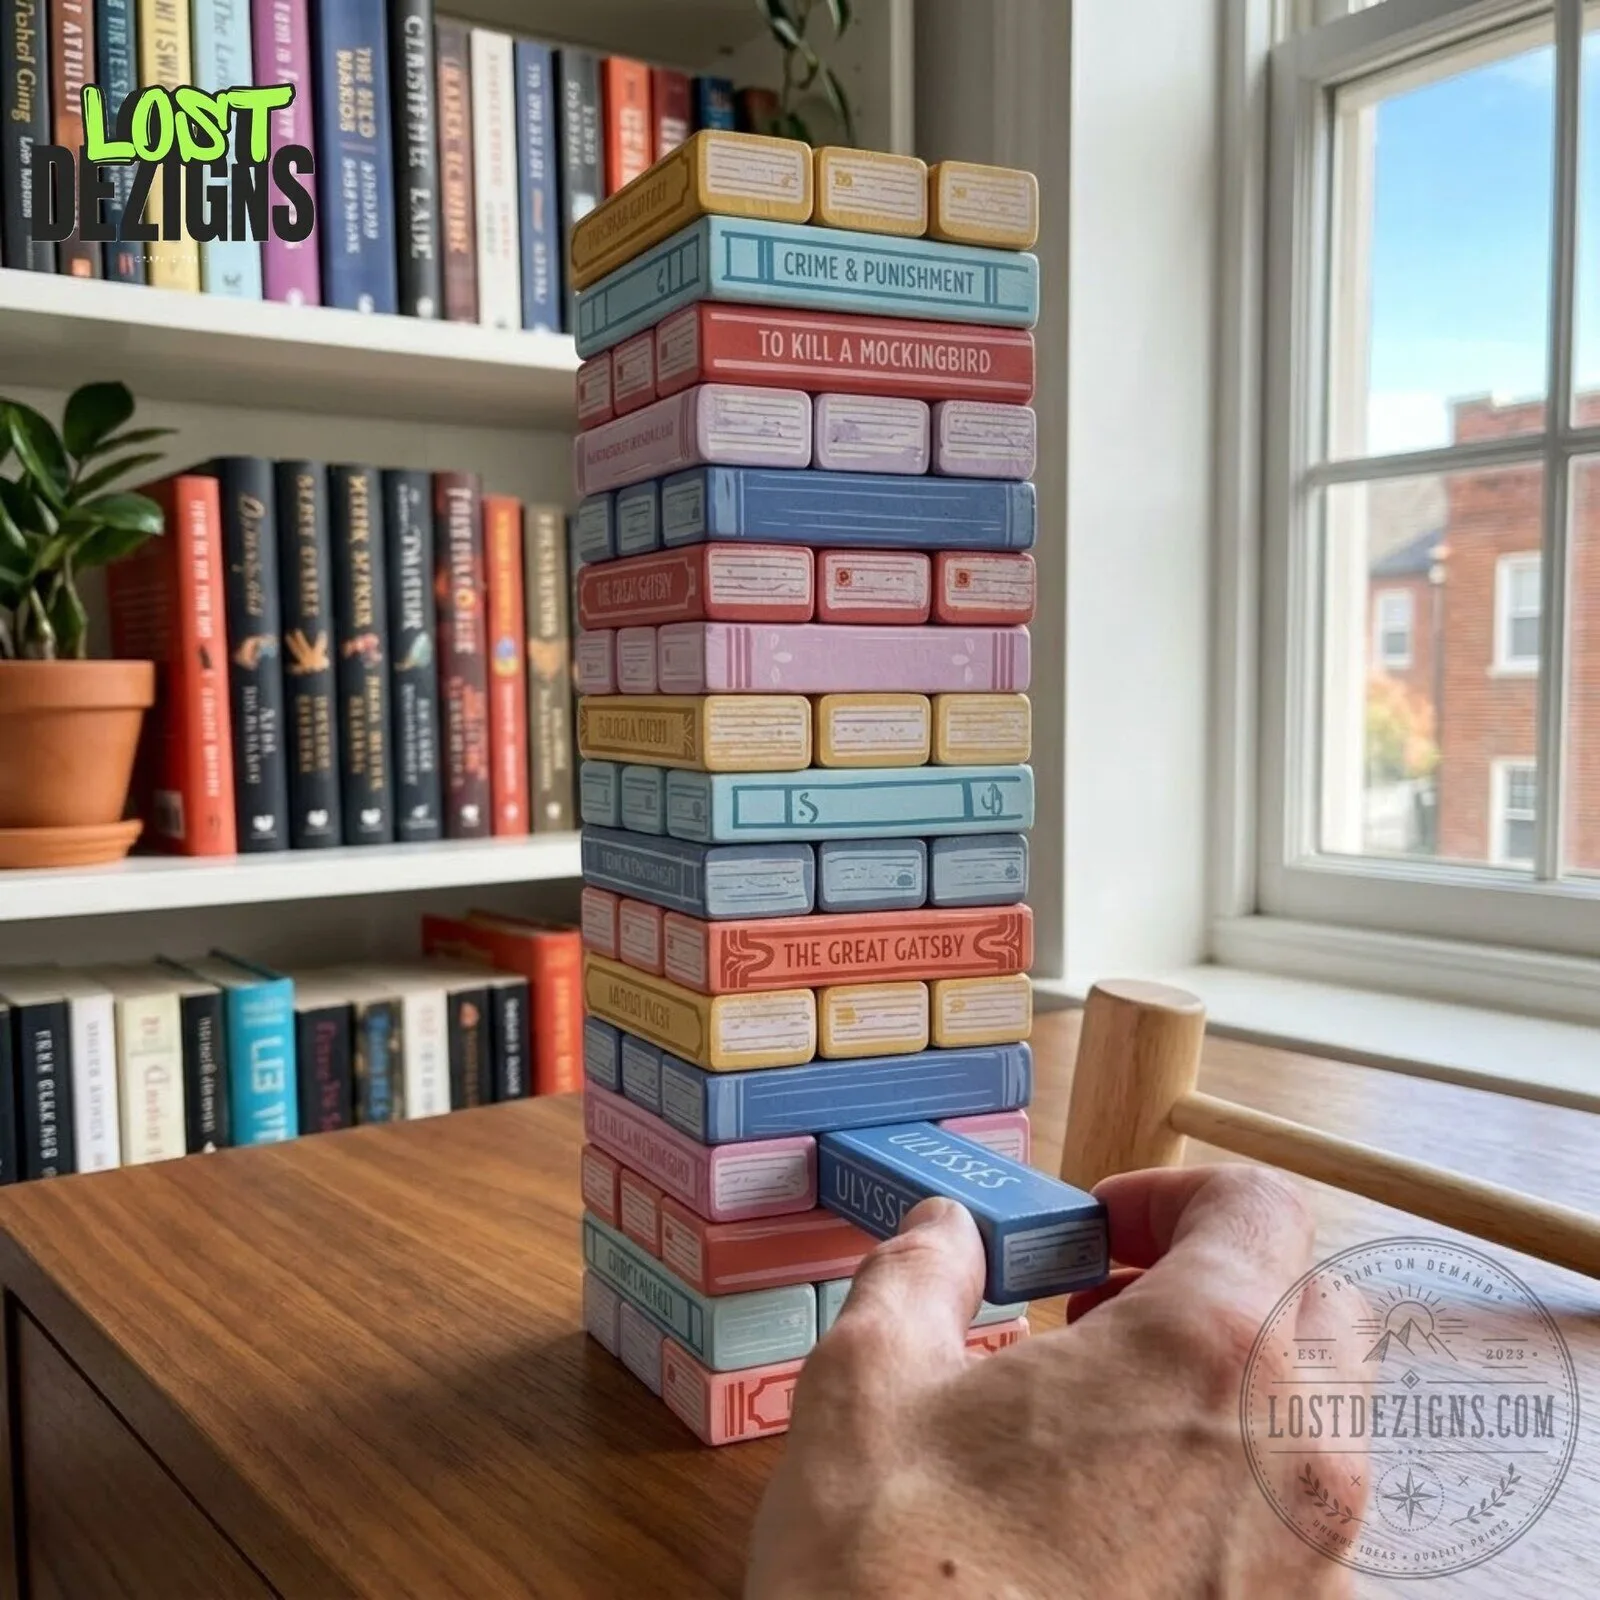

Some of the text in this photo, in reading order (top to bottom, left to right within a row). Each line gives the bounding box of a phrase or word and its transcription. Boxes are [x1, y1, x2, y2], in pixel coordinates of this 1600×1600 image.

[783, 251, 975, 294] CRIME & PUNISHMENT
[759, 329, 992, 374] TO KILL A MOCKINGBIRD
[784, 934, 965, 968] THE GREAT GATSBY
[887, 1131, 1022, 1189] ULYSSES
